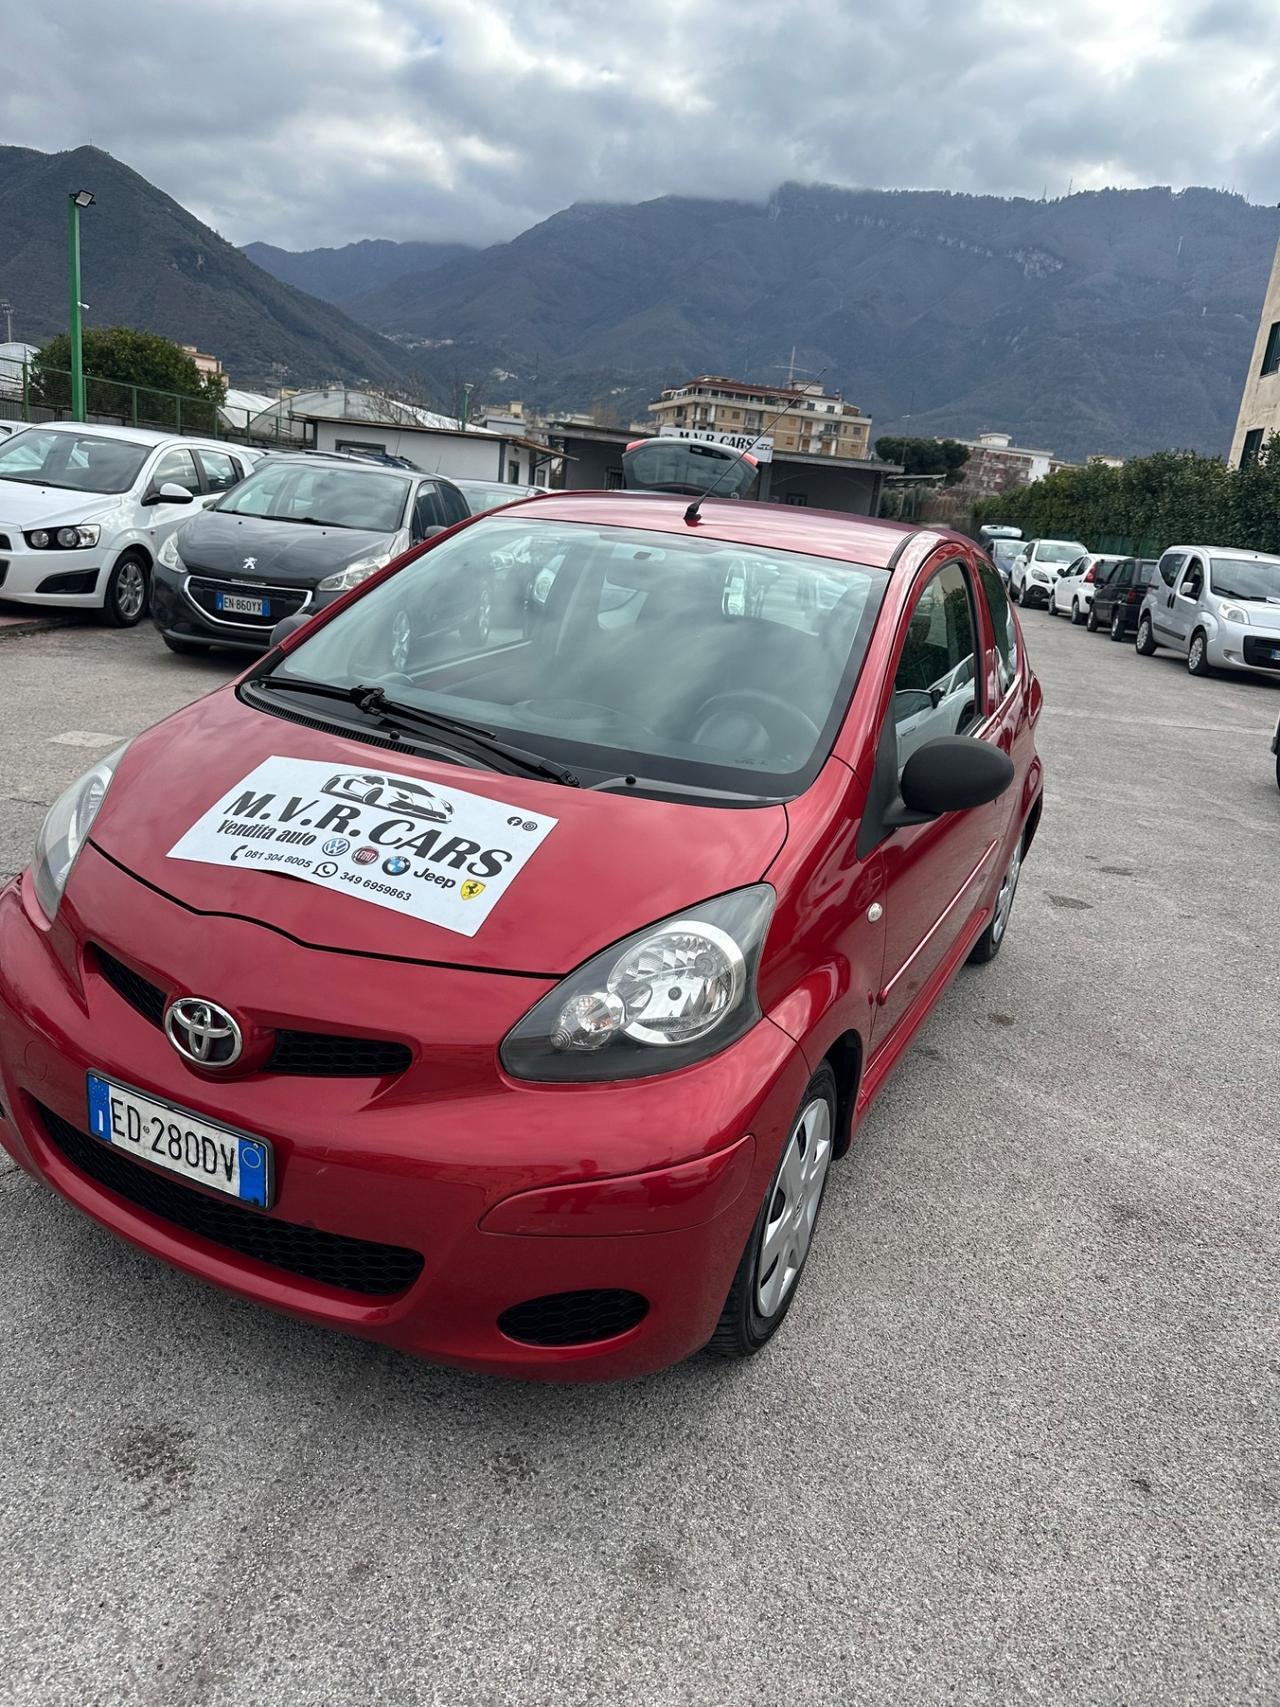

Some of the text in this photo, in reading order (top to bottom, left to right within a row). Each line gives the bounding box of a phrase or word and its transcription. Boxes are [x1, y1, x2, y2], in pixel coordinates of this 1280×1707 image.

[719, 436, 754, 449] CARS
[224, 597, 234, 608] EN
[216, 819, 317, 846] Vendita auto
[243, 850, 314, 869] 081 304 8005
[340, 871, 412, 902] 349 6959863
[413, 867, 456, 889] Jeep
[110, 1097, 236, 1182] ED 280DV
